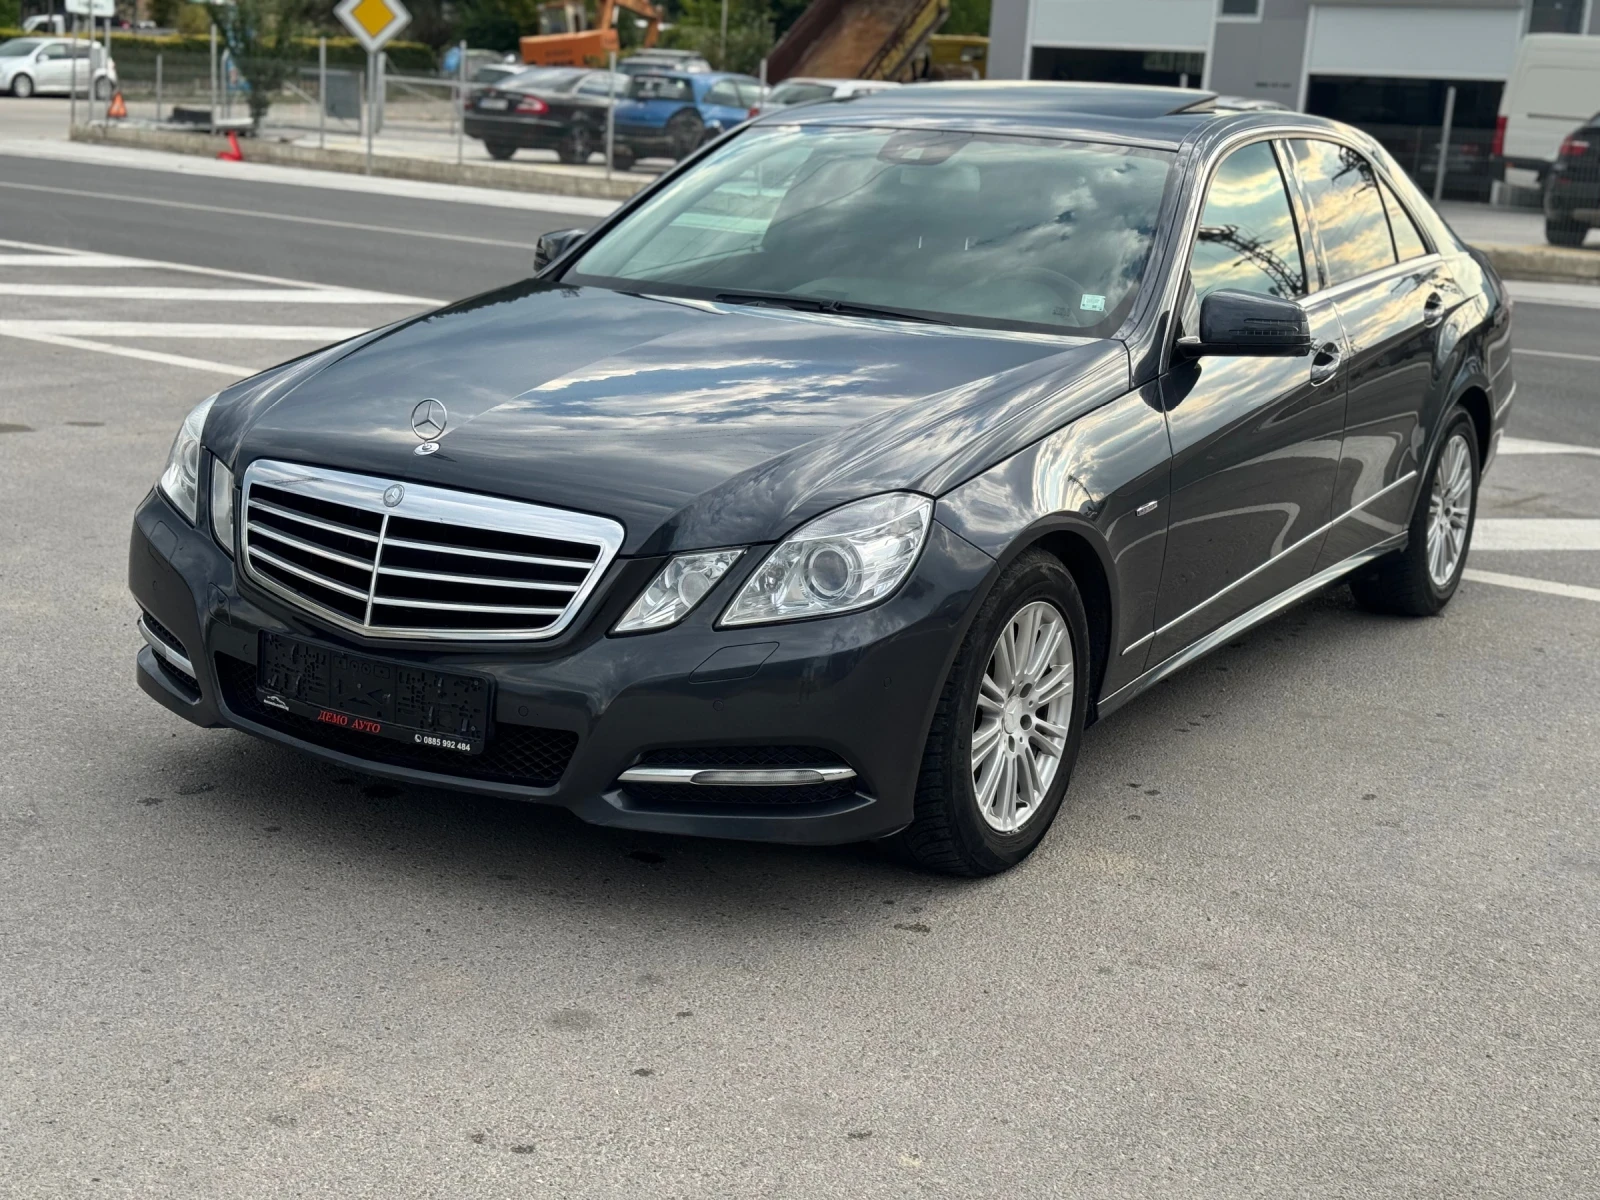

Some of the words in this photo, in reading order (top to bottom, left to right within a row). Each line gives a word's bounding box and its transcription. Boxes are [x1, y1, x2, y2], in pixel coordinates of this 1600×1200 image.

[318, 710, 348, 726] ДЕМО
[352, 719, 381, 733] АУТО
[423, 736, 441, 746] 0885
[442, 740, 456, 749] 992
[457, 743, 471, 751] 484
